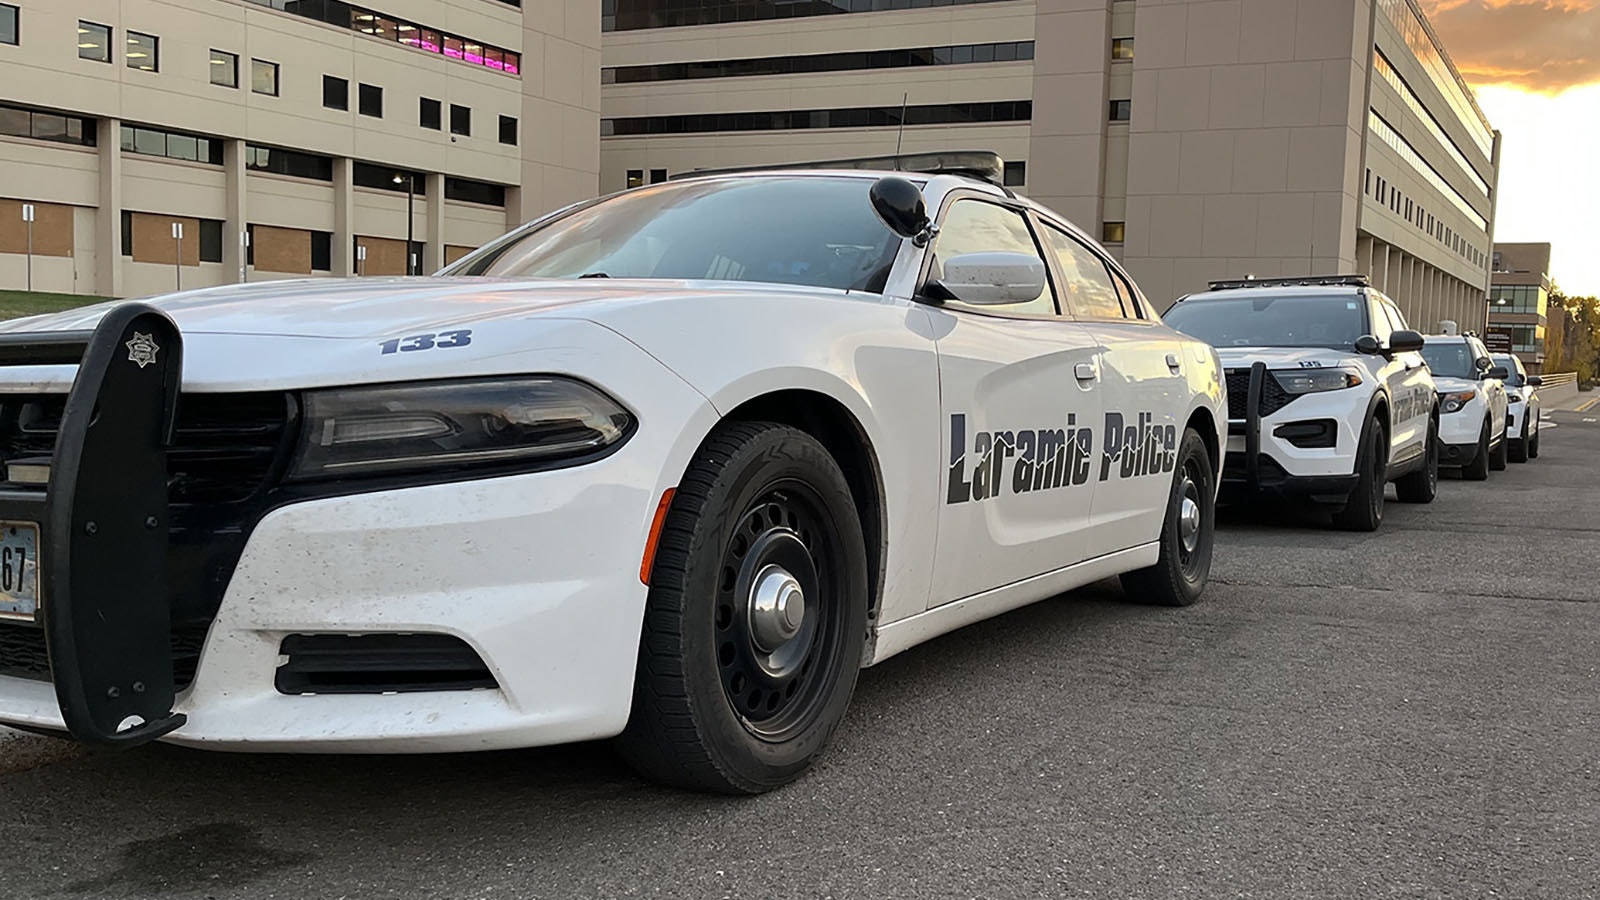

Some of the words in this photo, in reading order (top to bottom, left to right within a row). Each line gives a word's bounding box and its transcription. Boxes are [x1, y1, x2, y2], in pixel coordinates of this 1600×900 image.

[379, 329, 473, 355] 133
[946, 412, 1093, 504] Laramie
[1099, 411, 1177, 482] Police
[2, 546, 26, 592] 67
